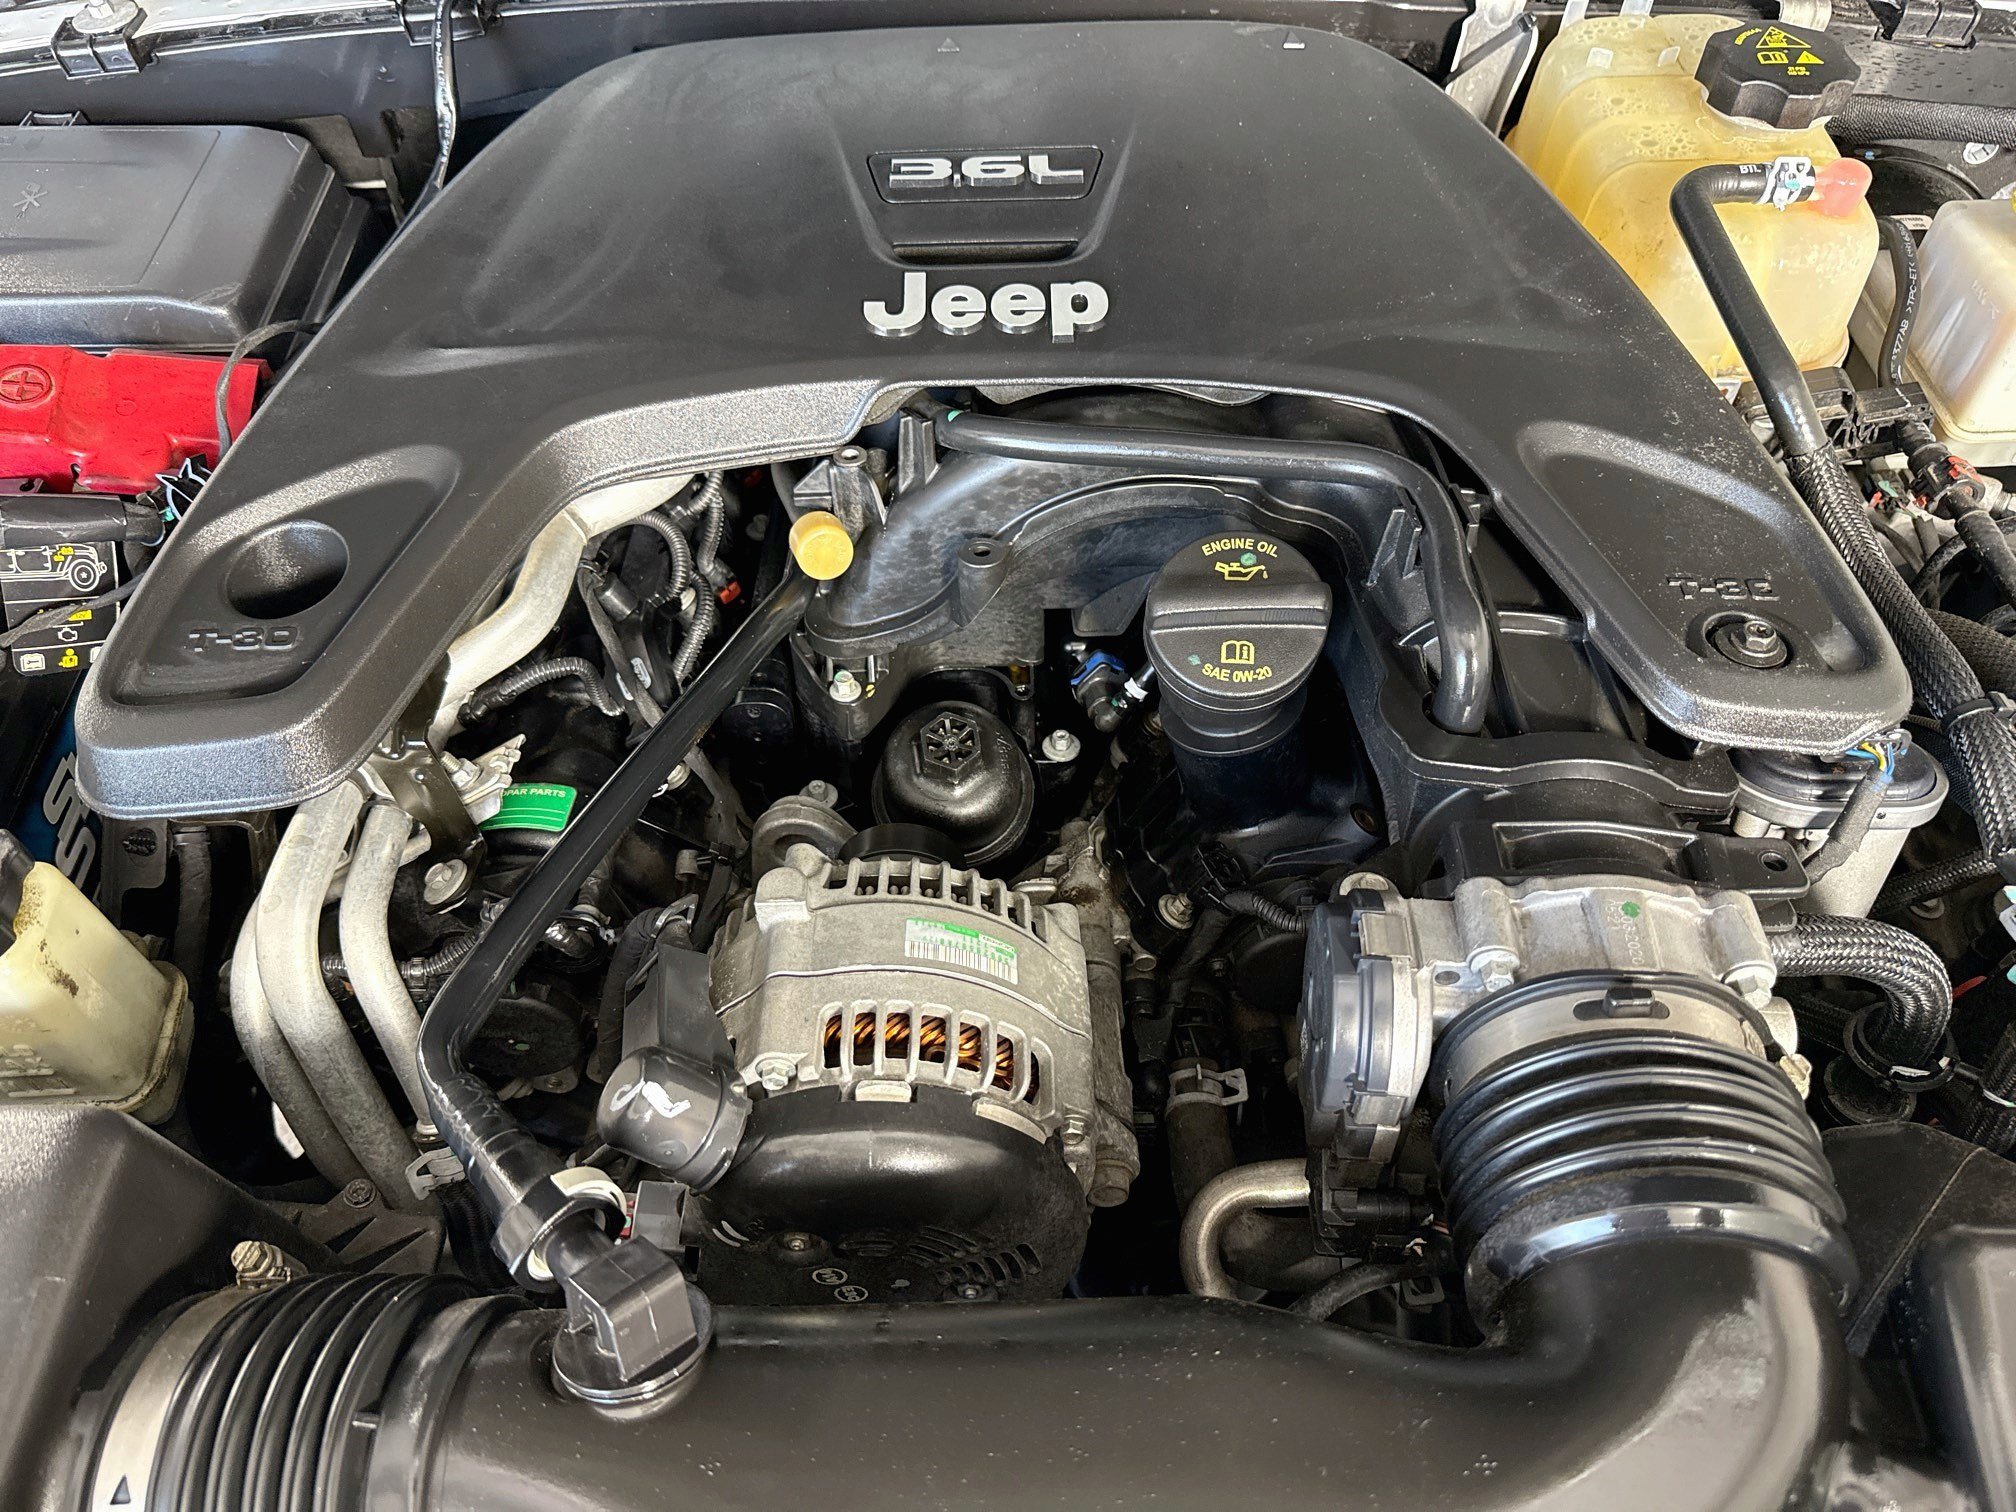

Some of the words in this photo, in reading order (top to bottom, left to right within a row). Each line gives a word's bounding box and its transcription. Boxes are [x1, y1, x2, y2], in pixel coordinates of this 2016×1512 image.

[888, 155, 1085, 188] 3.6L
[863, 272, 1109, 343] Jeep
[1202, 538, 1254, 556] ENGINE
[1257, 541, 1279, 557] OIL
[188, 625, 299, 653] T-30
[1202, 663, 1230, 681] SAE
[1232, 665, 1272, 682] 0W-20
[501, 788, 528, 797] OPAR
[529, 788, 566, 798] PARTS
